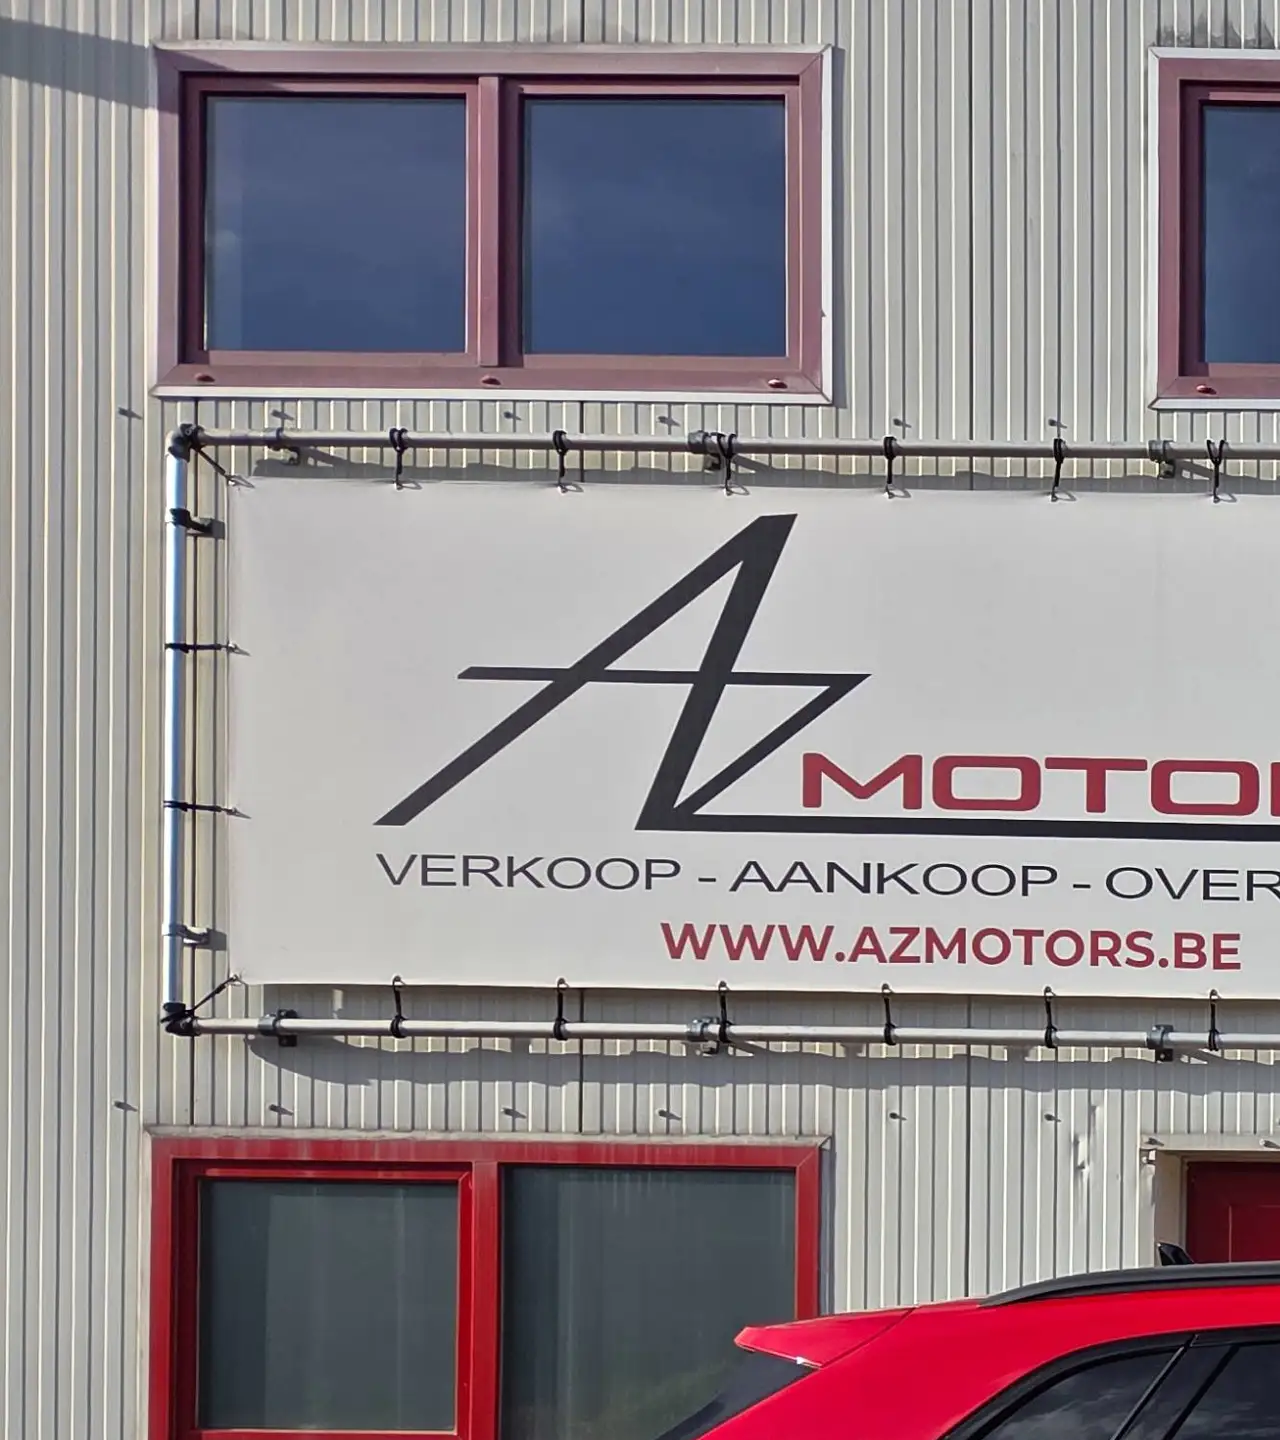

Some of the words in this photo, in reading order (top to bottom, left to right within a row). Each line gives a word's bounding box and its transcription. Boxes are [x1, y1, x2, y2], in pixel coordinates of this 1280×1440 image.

[376, 854, 681, 889] VERKOOP
[730, 861, 1057, 897] AANKOOP
[660, 923, 1241, 969] WWW.AZMOTORS.BE
